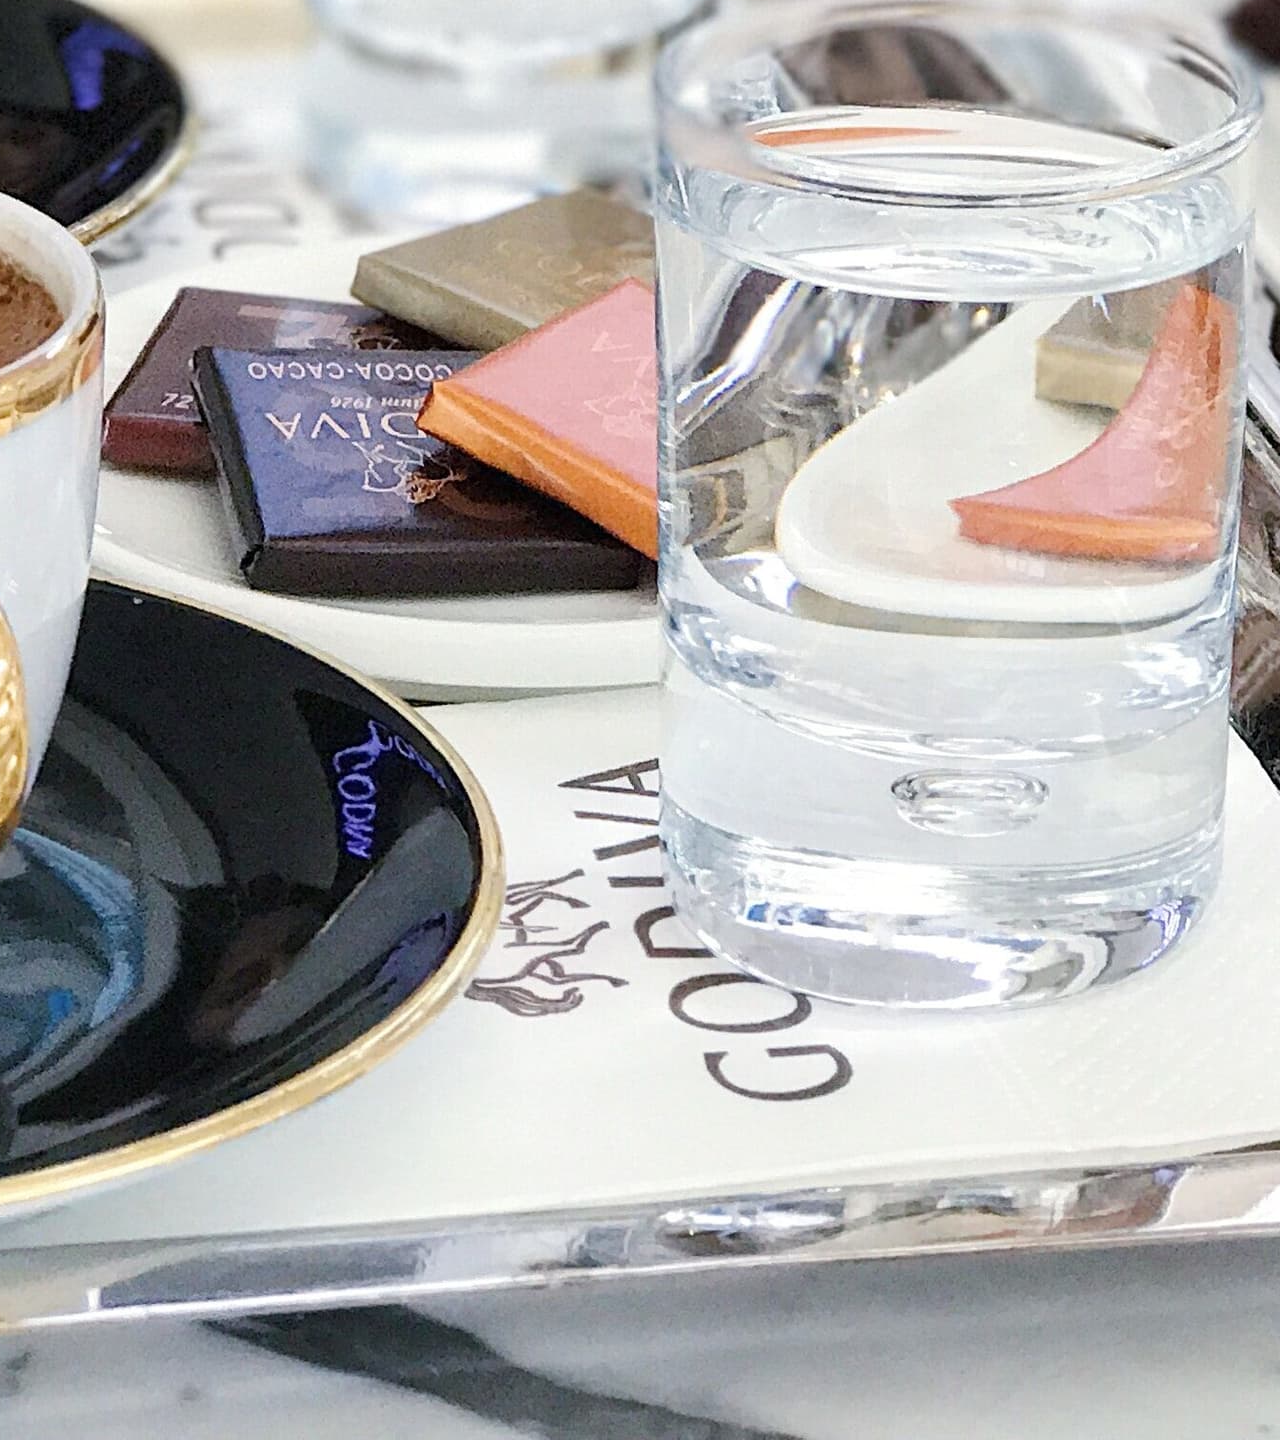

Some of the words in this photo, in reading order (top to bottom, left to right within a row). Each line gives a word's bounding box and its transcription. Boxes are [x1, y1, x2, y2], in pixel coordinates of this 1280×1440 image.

[247, 360, 453, 382] COCOA-CACAO
[329, 395, 373, 410] 1926
[265, 411, 428, 440] DIVA
[557, 757, 854, 1102] GODIVA
